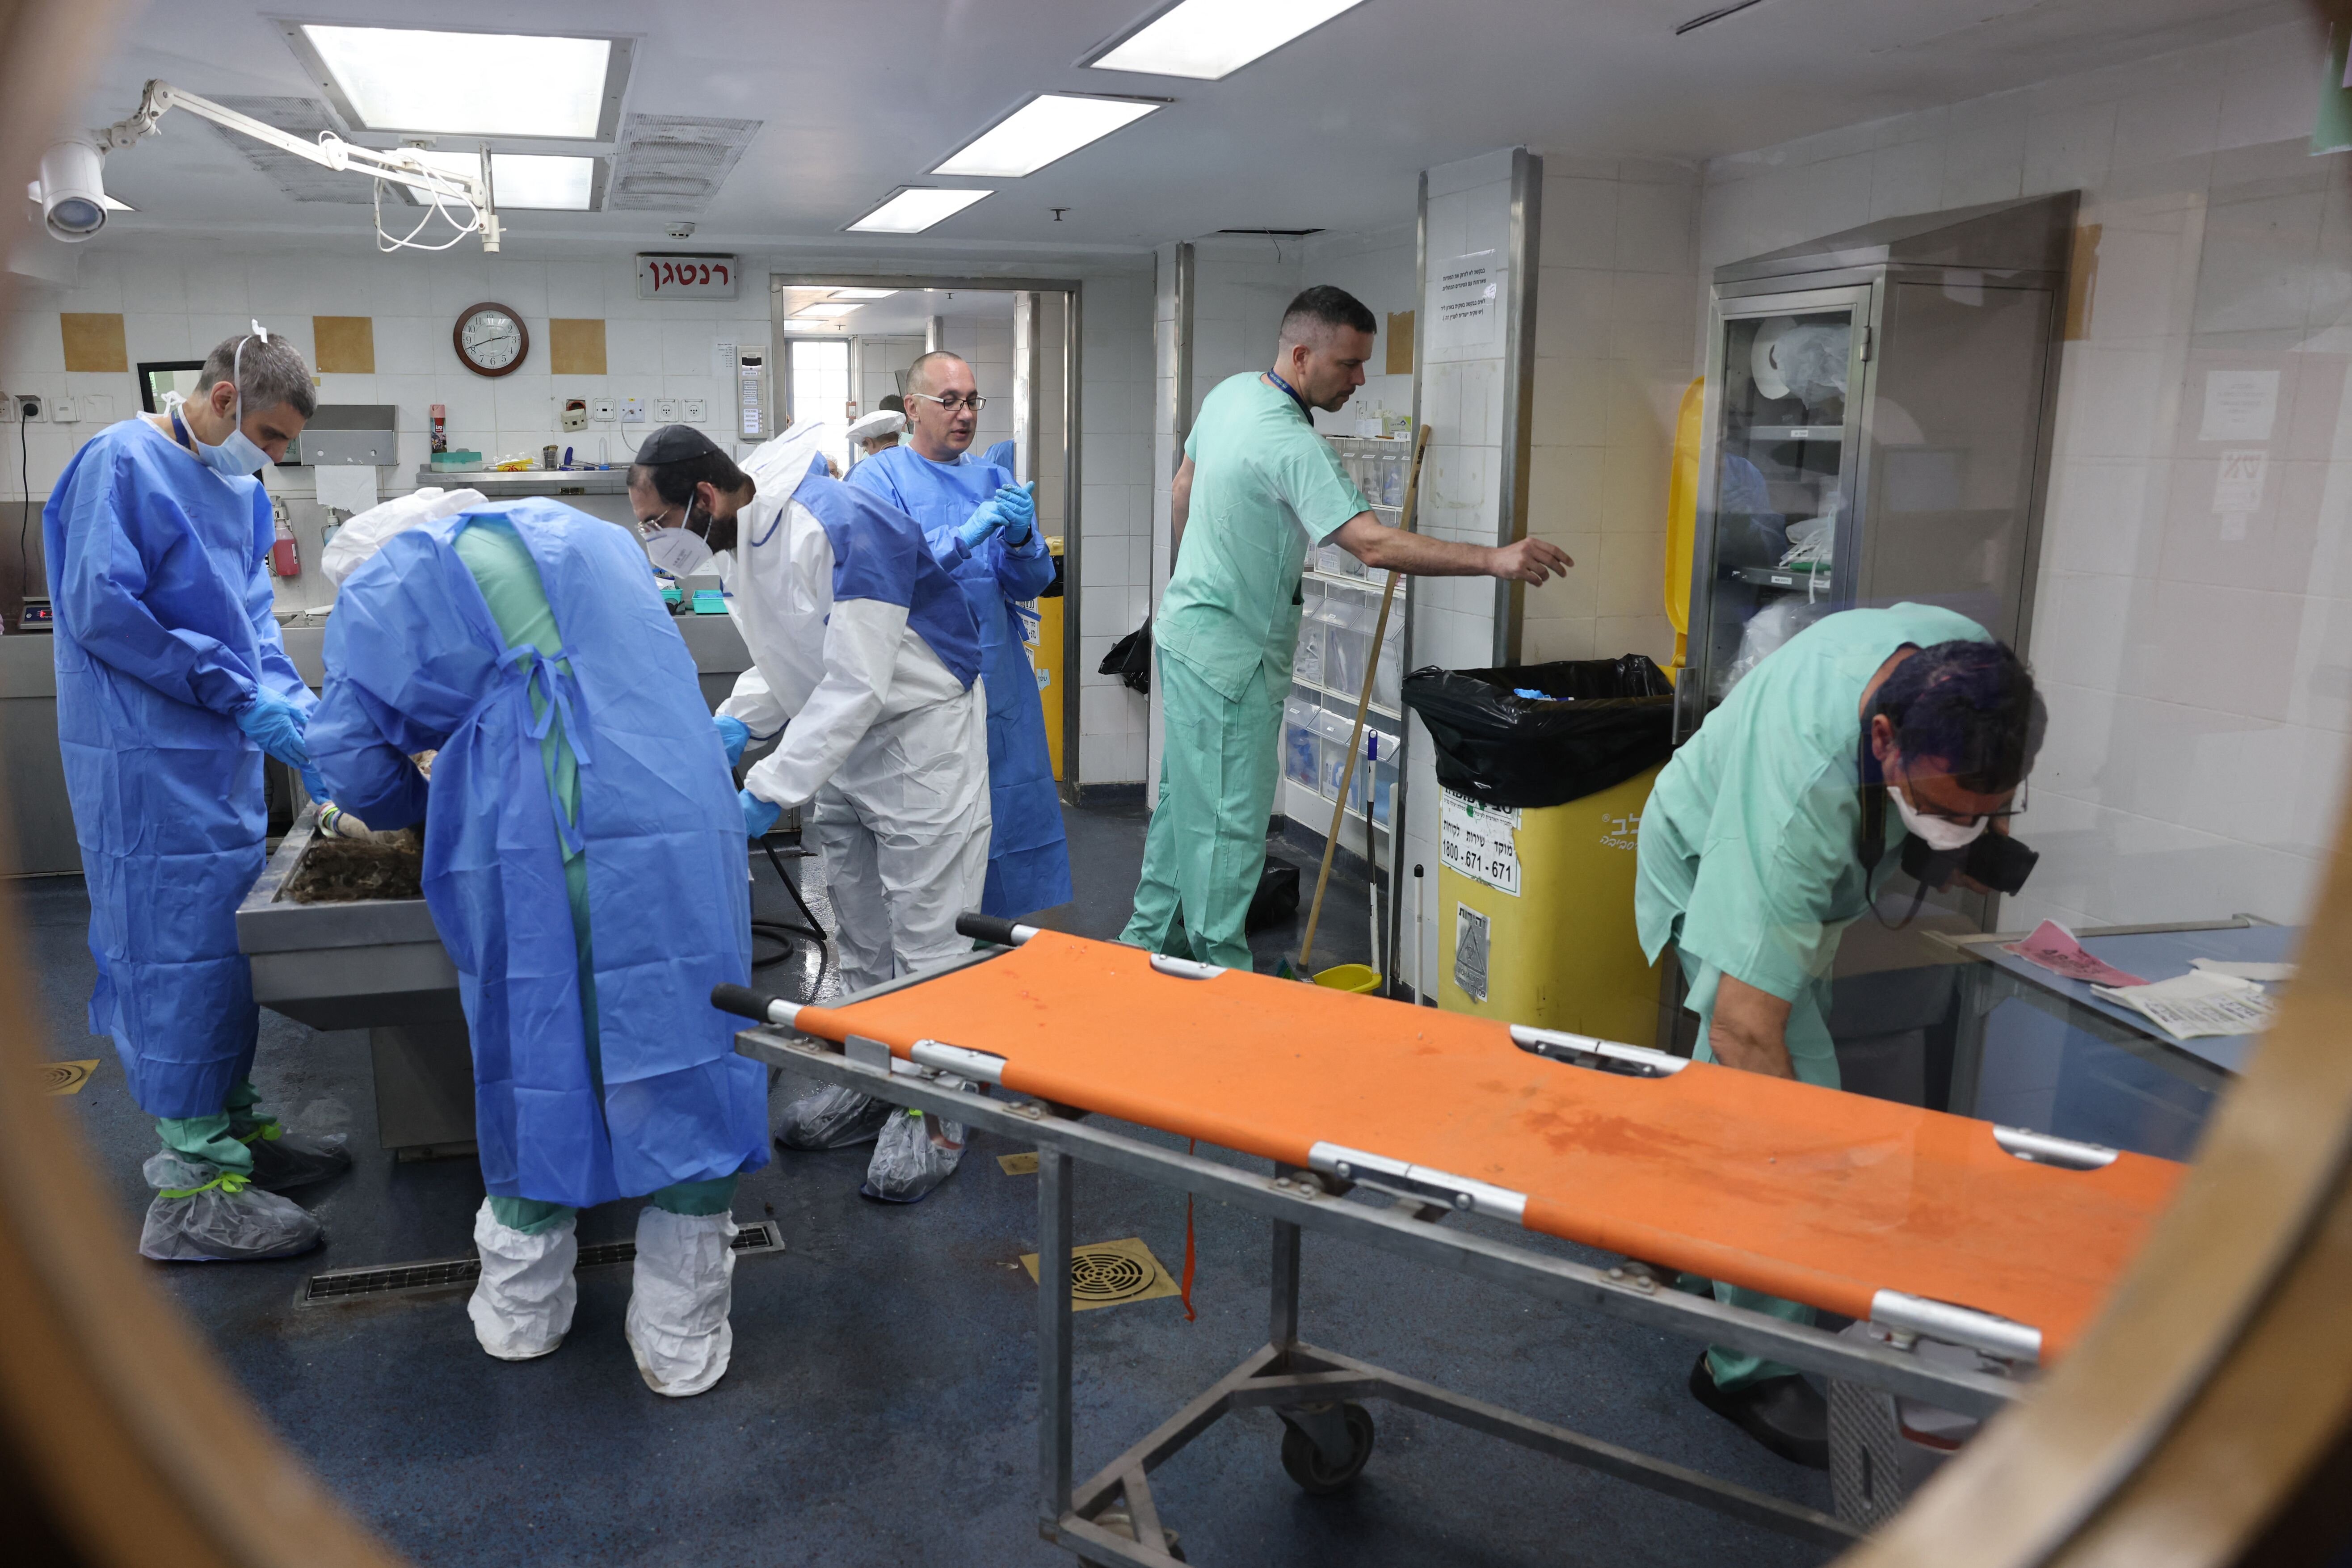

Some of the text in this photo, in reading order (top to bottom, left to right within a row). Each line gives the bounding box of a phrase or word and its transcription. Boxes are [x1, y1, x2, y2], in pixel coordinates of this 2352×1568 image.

[649, 261, 728, 291] רנטגן
[475, 317, 481, 325] 11
[466, 336, 471, 344] 9
[512, 336, 517, 344] 3
[471, 347, 476, 355] 8
[480, 355, 484, 363] 7
[490, 357, 496, 365] 6
[1443, 820, 1512, 857] מוקד שירות לקוחות
[1600, 836, 1638, 850] סביבה
[1443, 839, 1458, 861] 1800
[1466, 851, 1481, 871] 671
[1492, 861, 1510, 882] 671
[1459, 907, 1485, 929] זהירות
